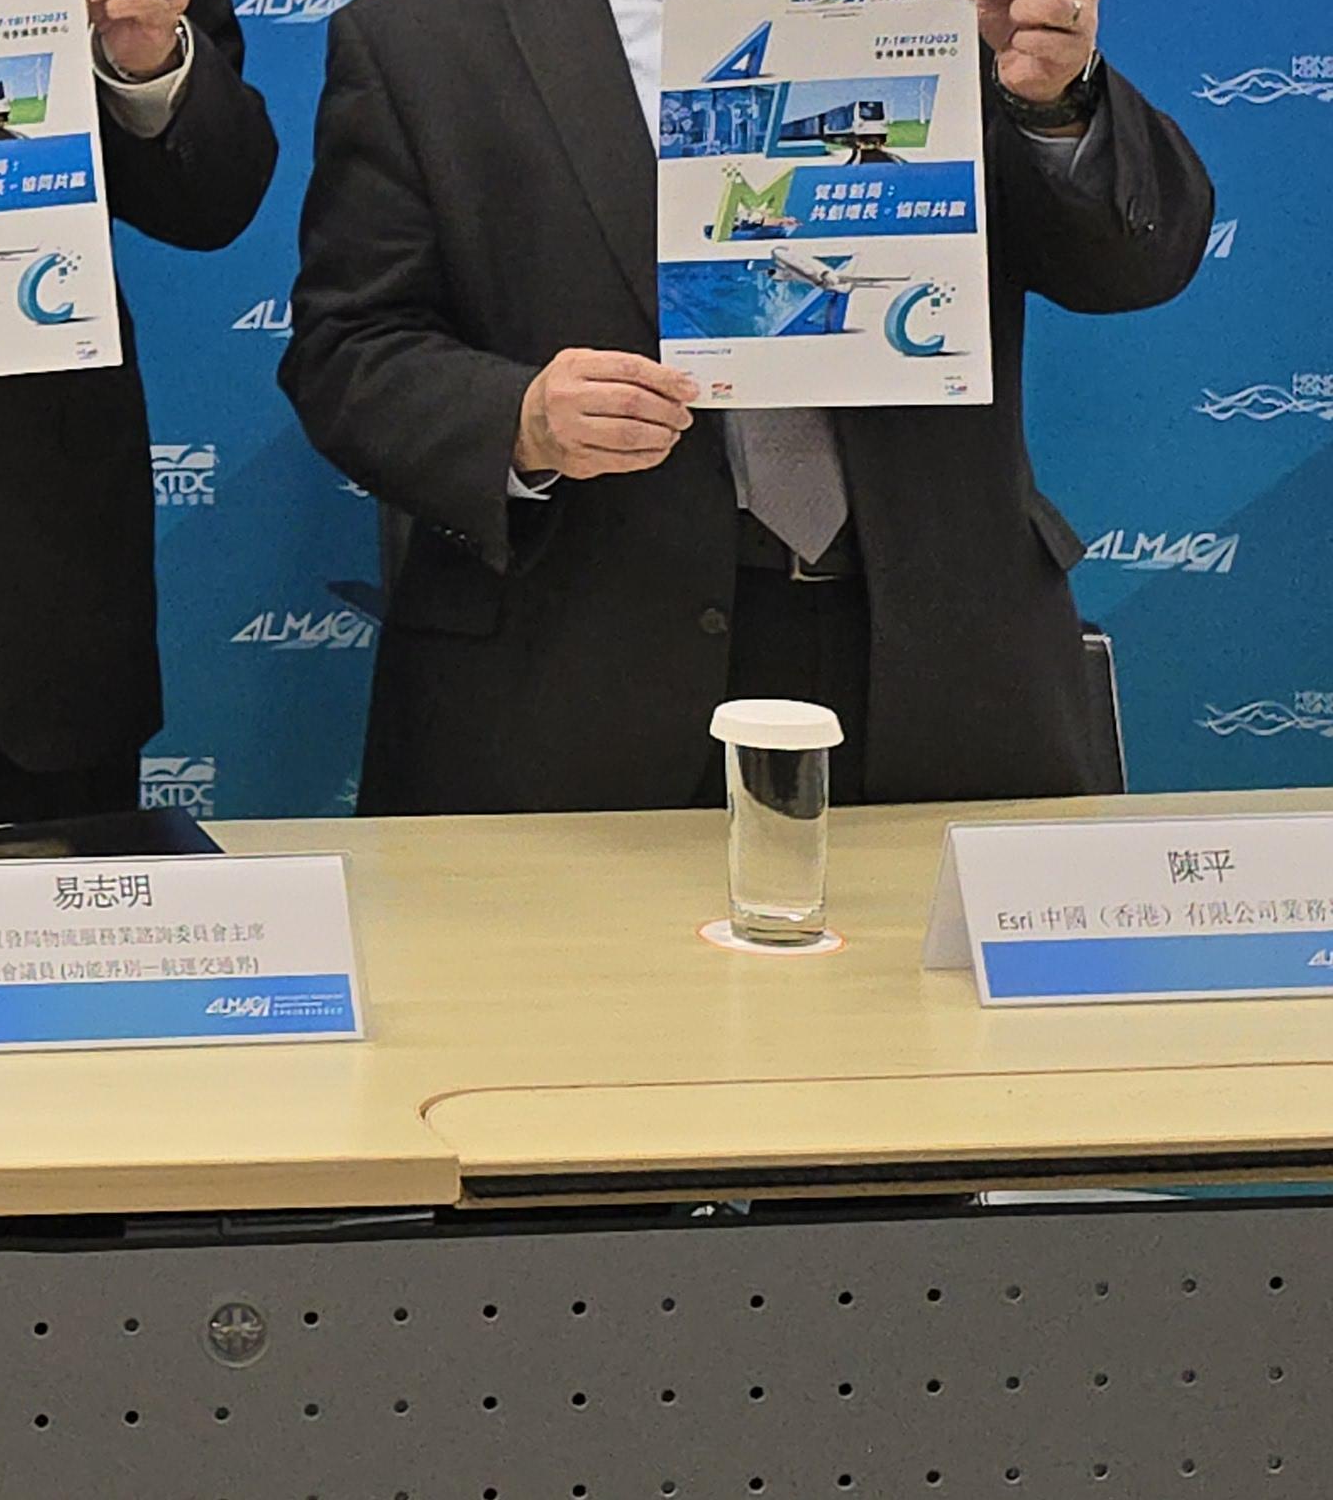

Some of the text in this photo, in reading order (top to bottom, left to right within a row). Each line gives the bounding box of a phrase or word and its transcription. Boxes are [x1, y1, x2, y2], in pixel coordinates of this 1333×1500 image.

[154, 471, 215, 494] KTDC
[140, 784, 214, 808] HKTDC
[1167, 848, 1235, 884] 陳平
[52, 873, 153, 911] 易志明
[997, 897, 1333, 931] Esri 中國（香港）有限公司業務
